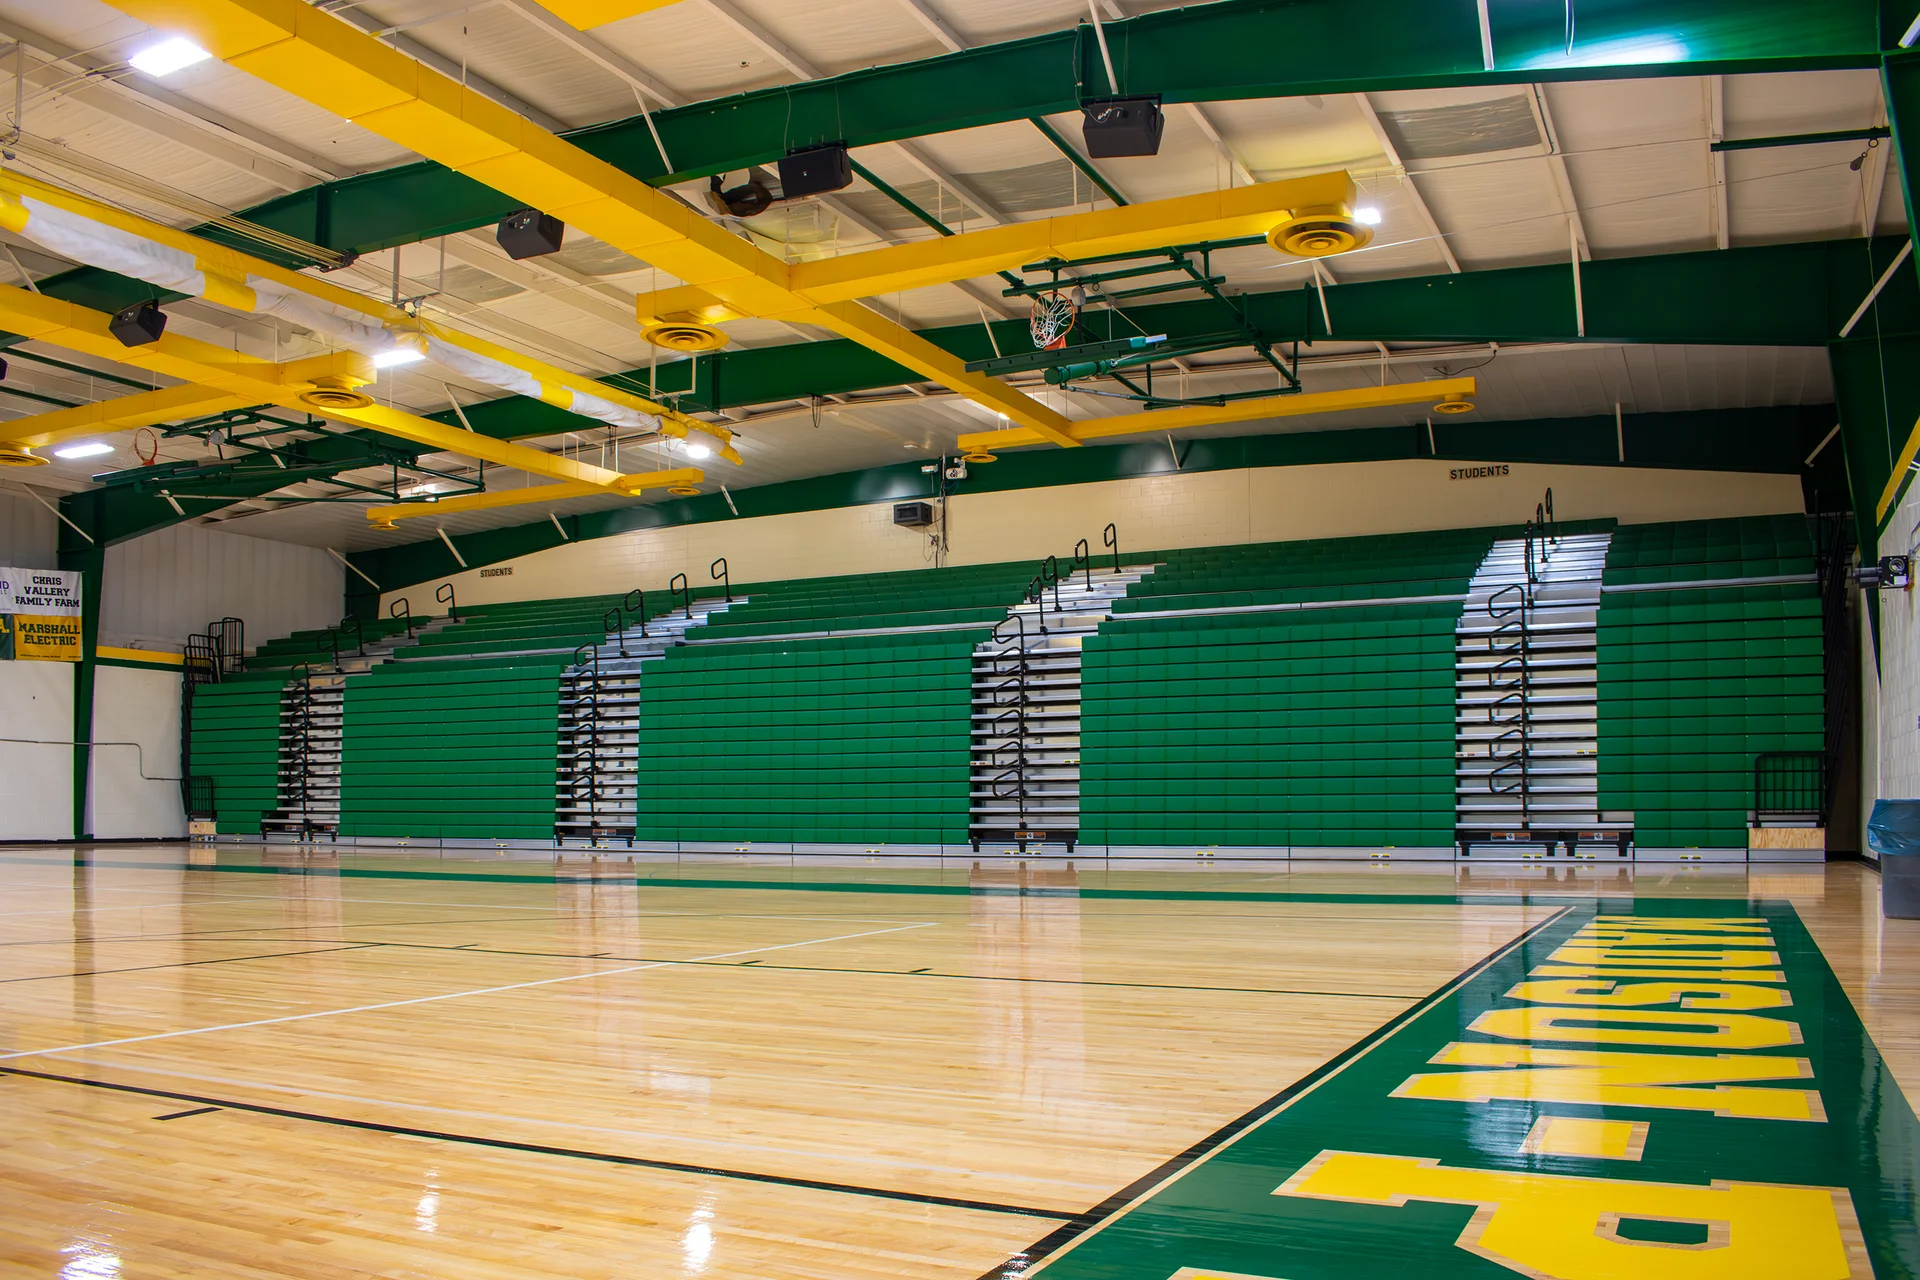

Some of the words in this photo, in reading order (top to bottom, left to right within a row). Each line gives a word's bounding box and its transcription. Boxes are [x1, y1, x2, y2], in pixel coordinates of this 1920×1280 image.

[1450, 464, 1509, 480] STUDENTS
[480, 567, 513, 578] STUDENTS
[32, 576, 62, 585] CHRIS
[24, 586, 70, 597] VALLERY
[15, 596, 53, 606] FAMILY
[54, 598, 80, 608] FARM
[18, 622, 81, 634] MARSHALL
[24, 634, 77, 646] ELECTRIC
[1167, 915, 1876, 1280] MADISON-P
